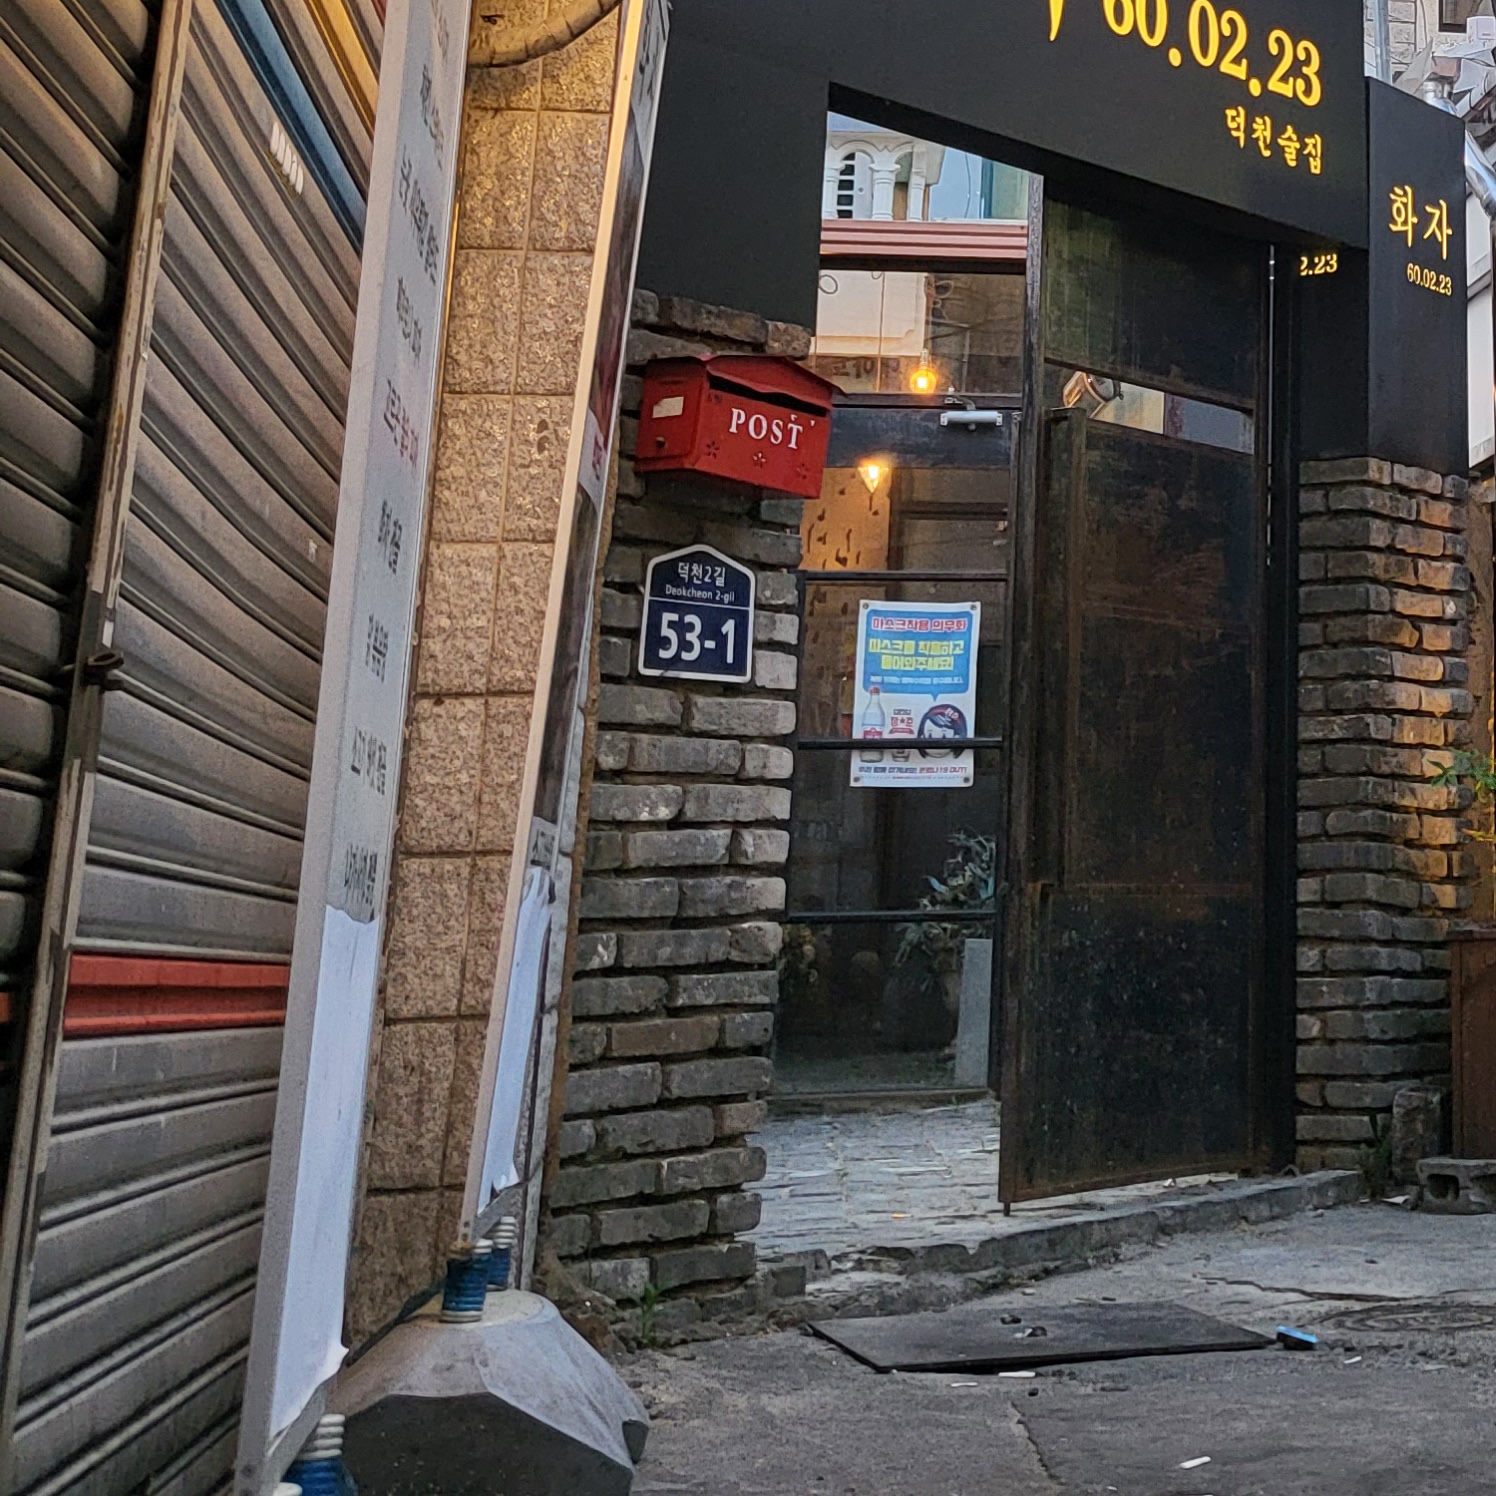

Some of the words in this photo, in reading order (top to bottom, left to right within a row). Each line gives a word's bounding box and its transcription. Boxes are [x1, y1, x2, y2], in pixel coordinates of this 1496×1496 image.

[1224, 105, 1324, 175] 덕천술집
[1388, 185, 1453, 261] 화자
[1406, 262, 1453, 297] 60.02.23
[728, 407, 804, 450] POST
[665, 584, 713, 600] Deokcheon
[677, 561, 727, 588] 덕천2길
[658, 611, 737, 665] 53-1
